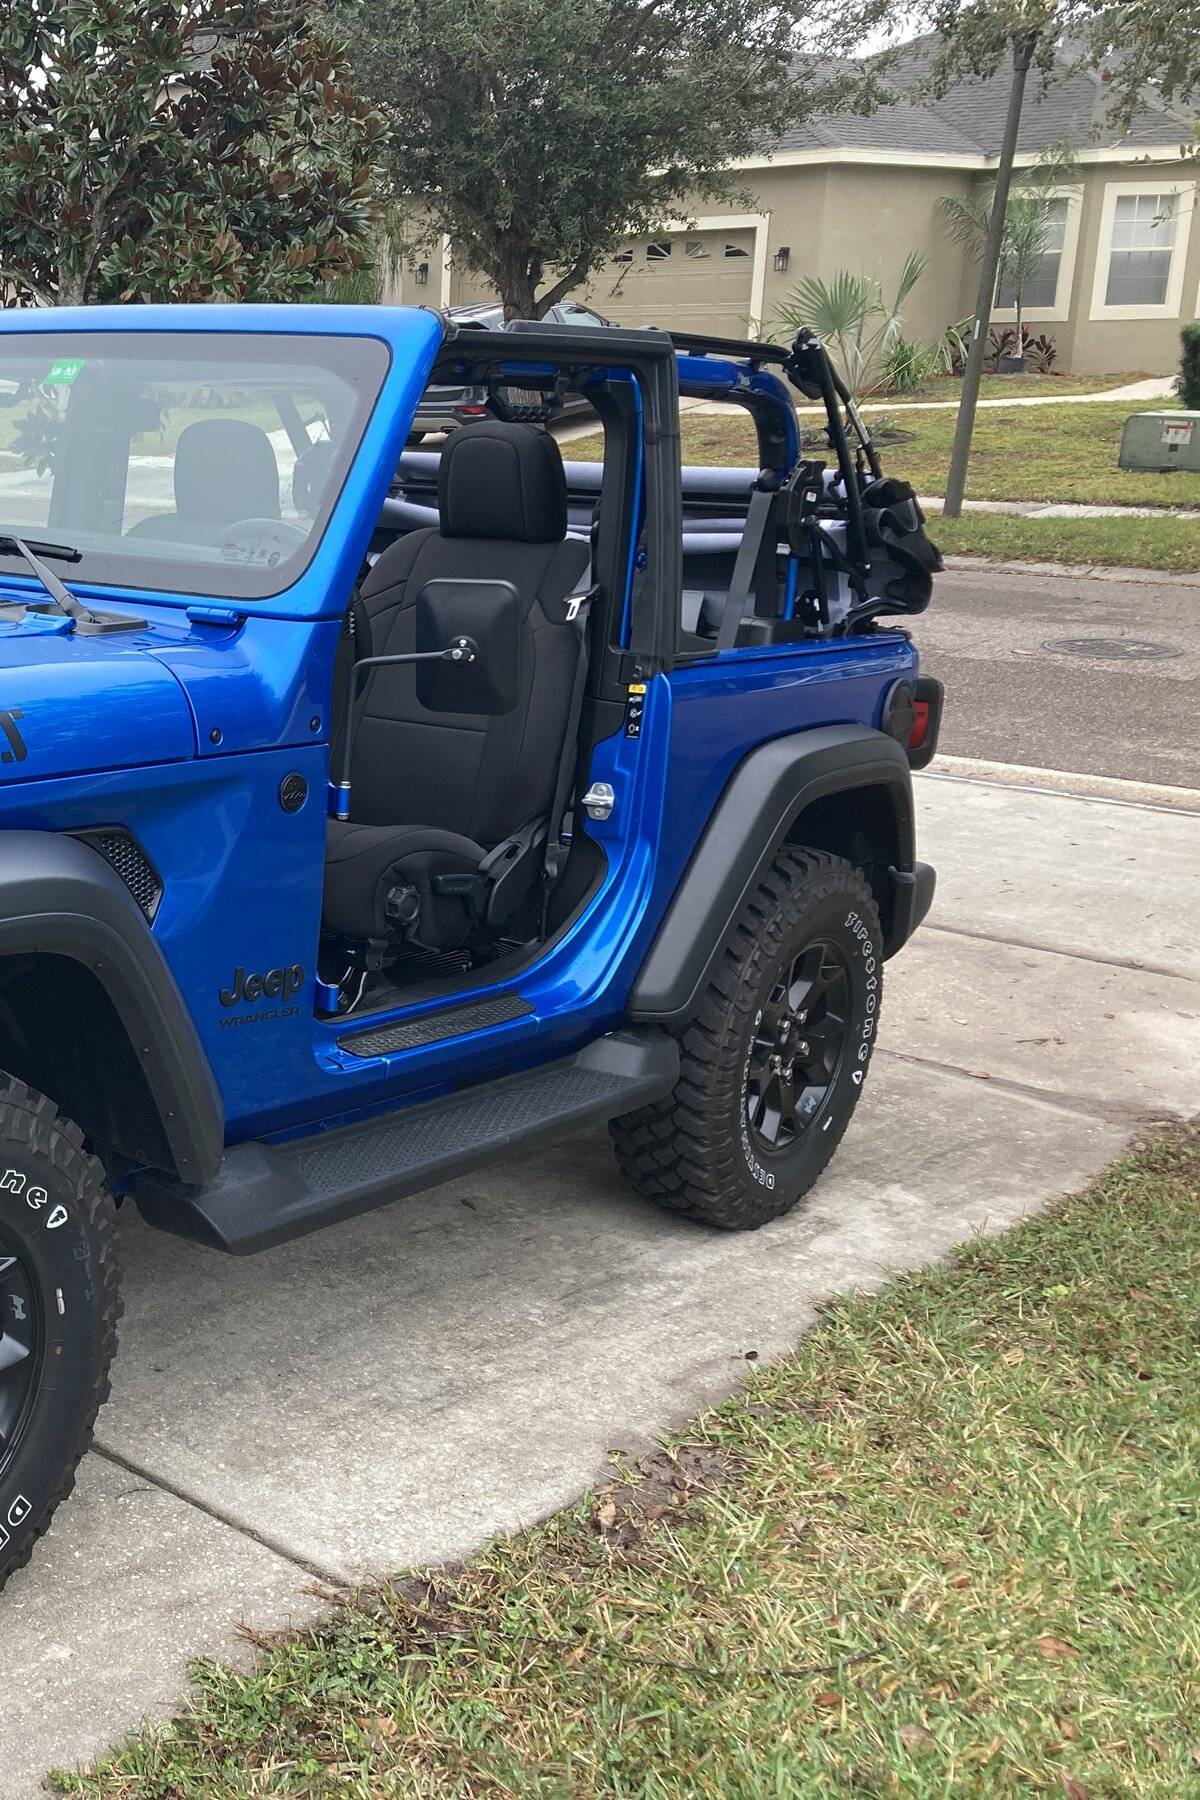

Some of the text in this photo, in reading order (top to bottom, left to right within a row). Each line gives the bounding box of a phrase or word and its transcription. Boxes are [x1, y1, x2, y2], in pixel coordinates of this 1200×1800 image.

[219, 964, 304, 1008] Jeep
[844, 911, 878, 1062] Firestone
[219, 1006, 300, 1029] WRANGLER
